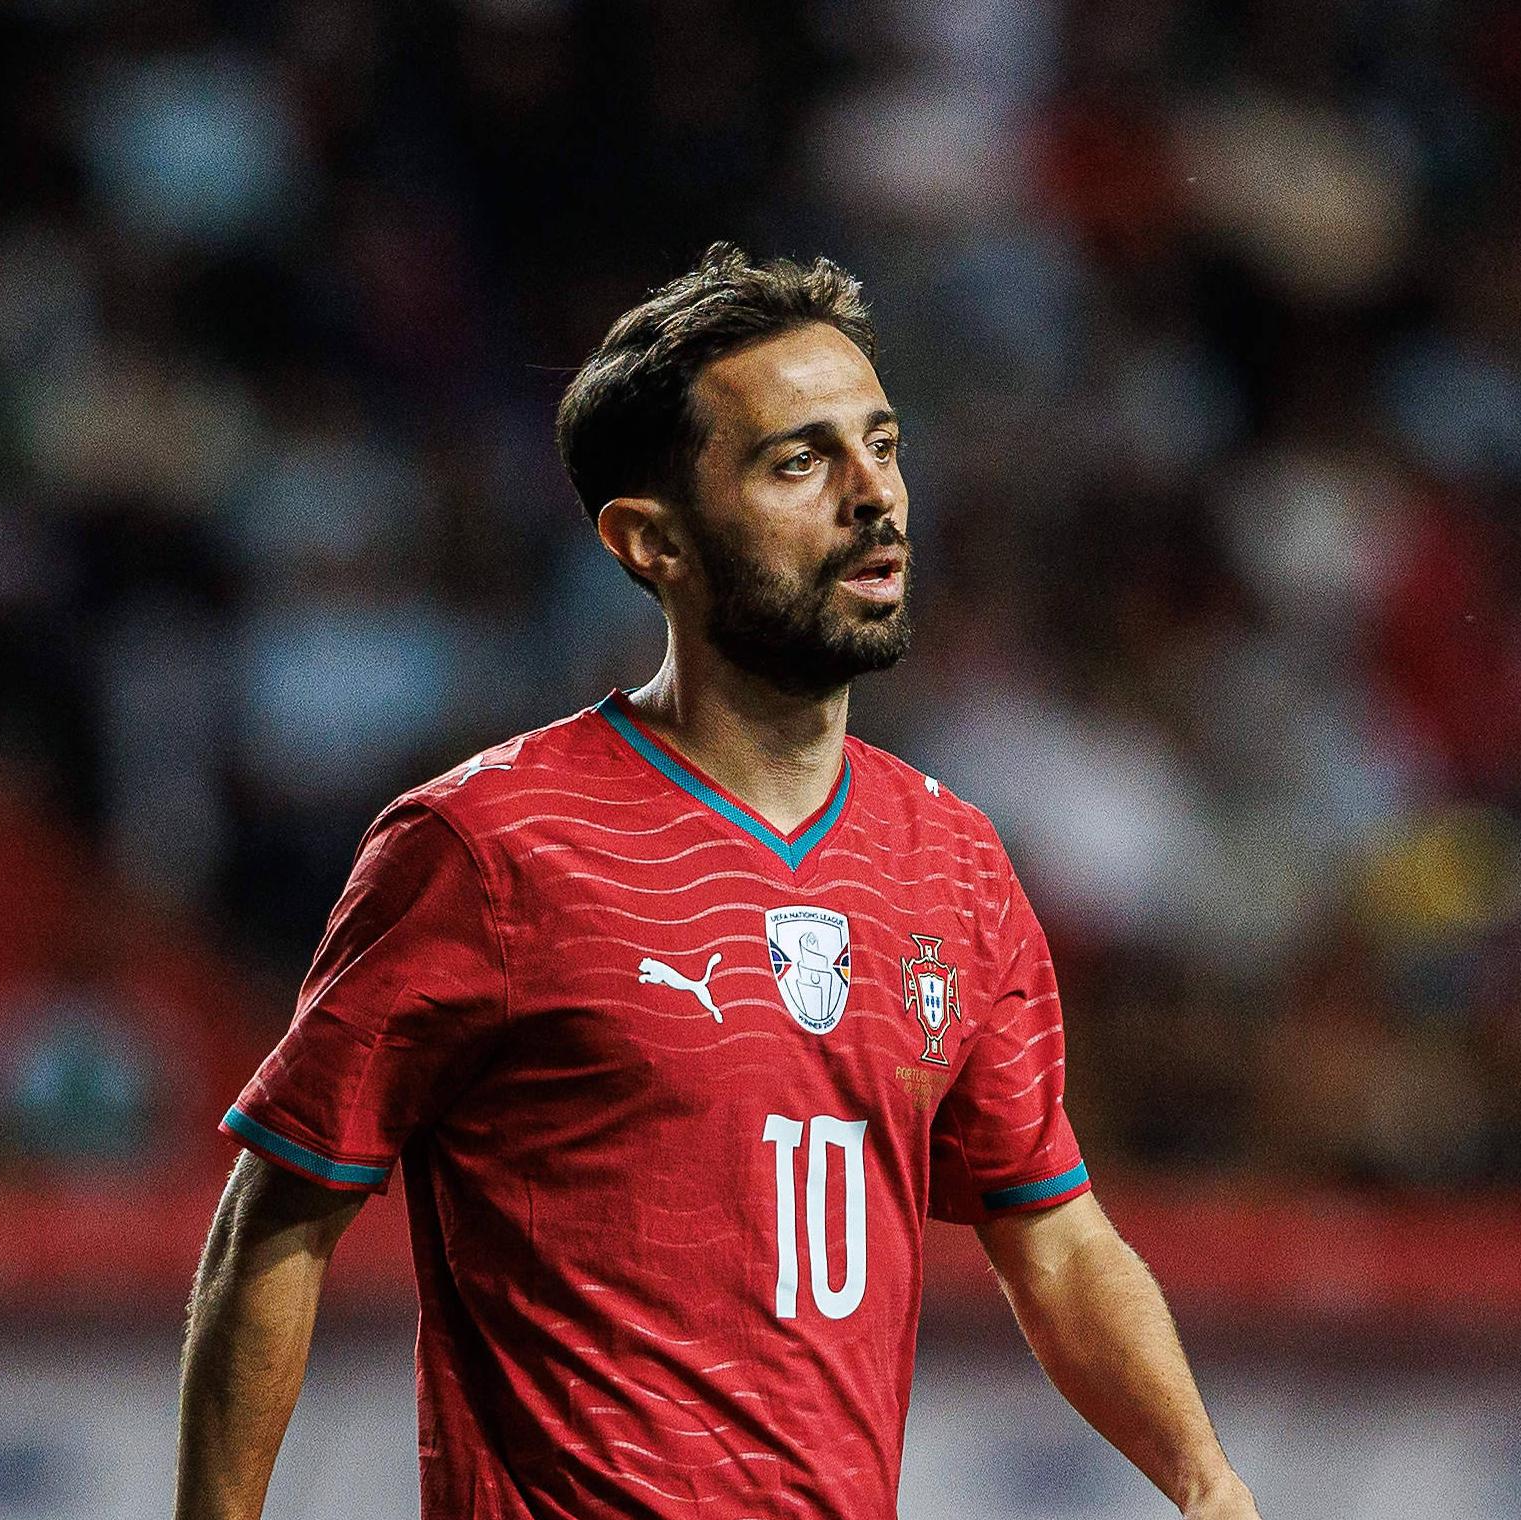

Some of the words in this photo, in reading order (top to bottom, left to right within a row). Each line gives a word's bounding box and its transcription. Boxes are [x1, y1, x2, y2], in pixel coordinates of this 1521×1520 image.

[770, 912, 788, 923] UEFA
[789, 911, 819, 919] NATIONS
[820, 914, 844, 927] LEAGUE
[757, 1114, 868, 1319] 10
